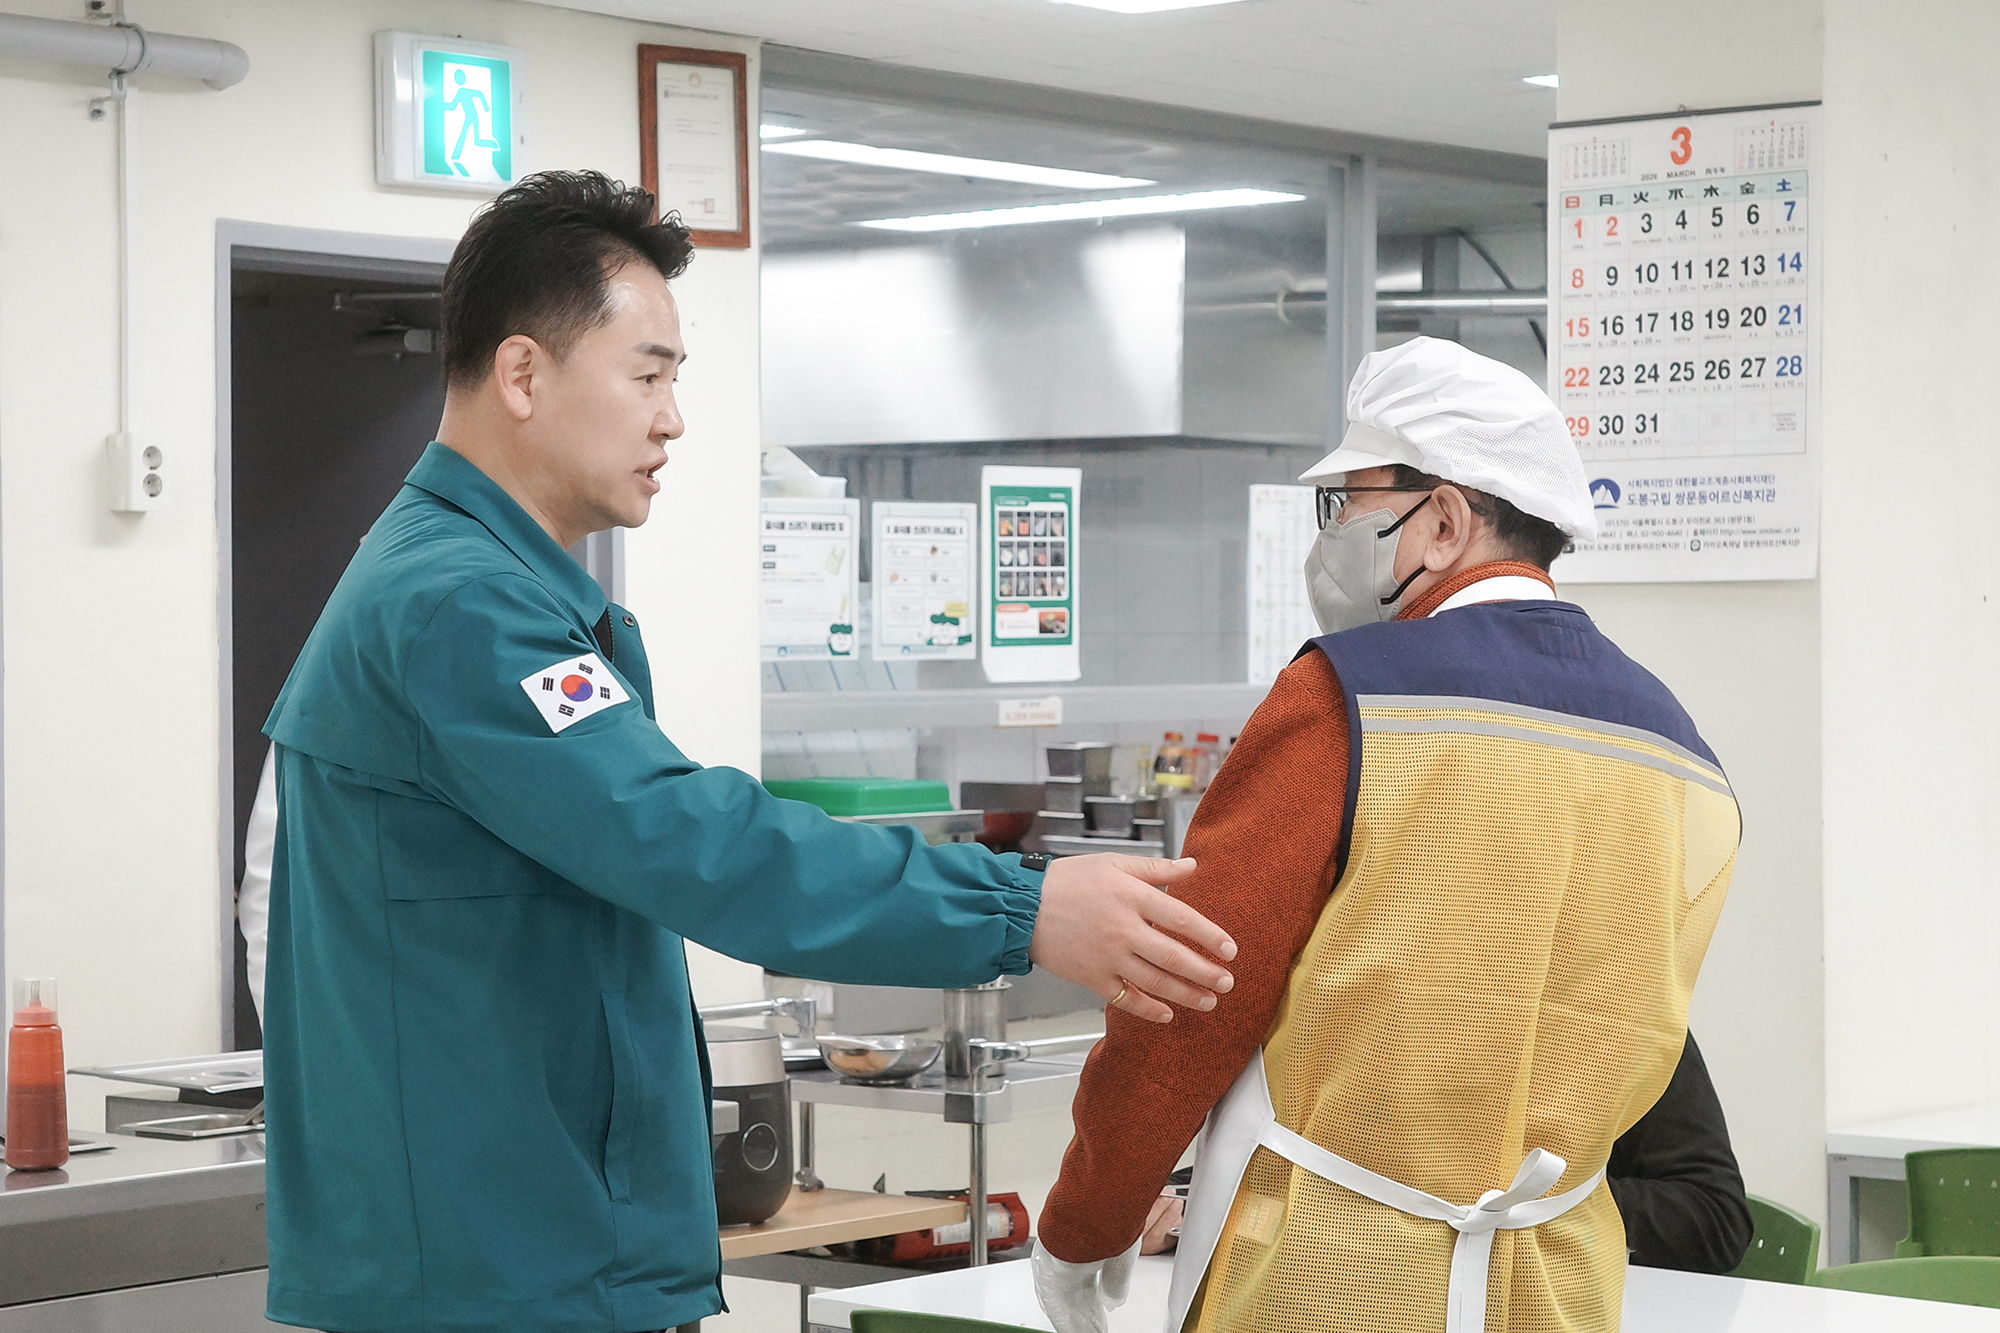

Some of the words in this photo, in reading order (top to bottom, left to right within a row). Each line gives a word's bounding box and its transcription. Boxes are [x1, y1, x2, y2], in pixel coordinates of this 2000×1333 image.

[1670, 126, 1692, 166] 3
[1666, 168, 1696, 179] MARCH
[1565, 195, 1581, 209] 日
[1599, 193, 1614, 207] 月
[1633, 191, 1649, 204] 火
[1739, 181, 1756, 195] 金
[1775, 178, 1792, 193] 土
[1574, 218, 1582, 239] 1
[1606, 215, 1618, 237] 2
[1640, 213, 1653, 234] 3
[1675, 209, 1688, 230] 4
[1711, 206, 1724, 228] 5
[1746, 203, 1760, 225] 6
[1783, 200, 1796, 222] 7
[1571, 268, 1585, 289] 8
[1606, 265, 1619, 287] 9
[1635, 262, 1659, 284] 10
[1671, 259, 1693, 281] 11
[1704, 257, 1730, 279] 12
[1740, 254, 1766, 276] 13
[1777, 252, 1803, 273] 14
[1565, 317, 1590, 338] 15
[1600, 315, 1624, 336] 16
[1635, 312, 1659, 334] 17
[1669, 310, 1694, 332] 18
[1704, 308, 1730, 330] 19
[1740, 305, 1767, 328] 20
[1778, 304, 1802, 326] 21
[1564, 367, 1590, 388] 22
[1599, 364, 1625, 386] 23
[1634, 363, 1660, 384] 24
[1669, 361, 1695, 382] 25
[1704, 359, 1731, 381] 26
[1740, 357, 1767, 379] 27
[1775, 355, 1803, 377] 28
[1565, 416, 1590, 437] 29
[1598, 414, 1624, 436] 30
[1635, 413, 1658, 434] 31
[1627, 477, 1673, 489] 사회복지법인
[1675, 474, 1776, 488] 대한불교조계종사회복지재단
[1627, 491, 1672, 507] 도봉구립
[1675, 488, 1777, 506] 쌍문동어르신복지관
[1631, 517, 1664, 528] 서울특별시
[1665, 516, 1685, 527] 도봉구
